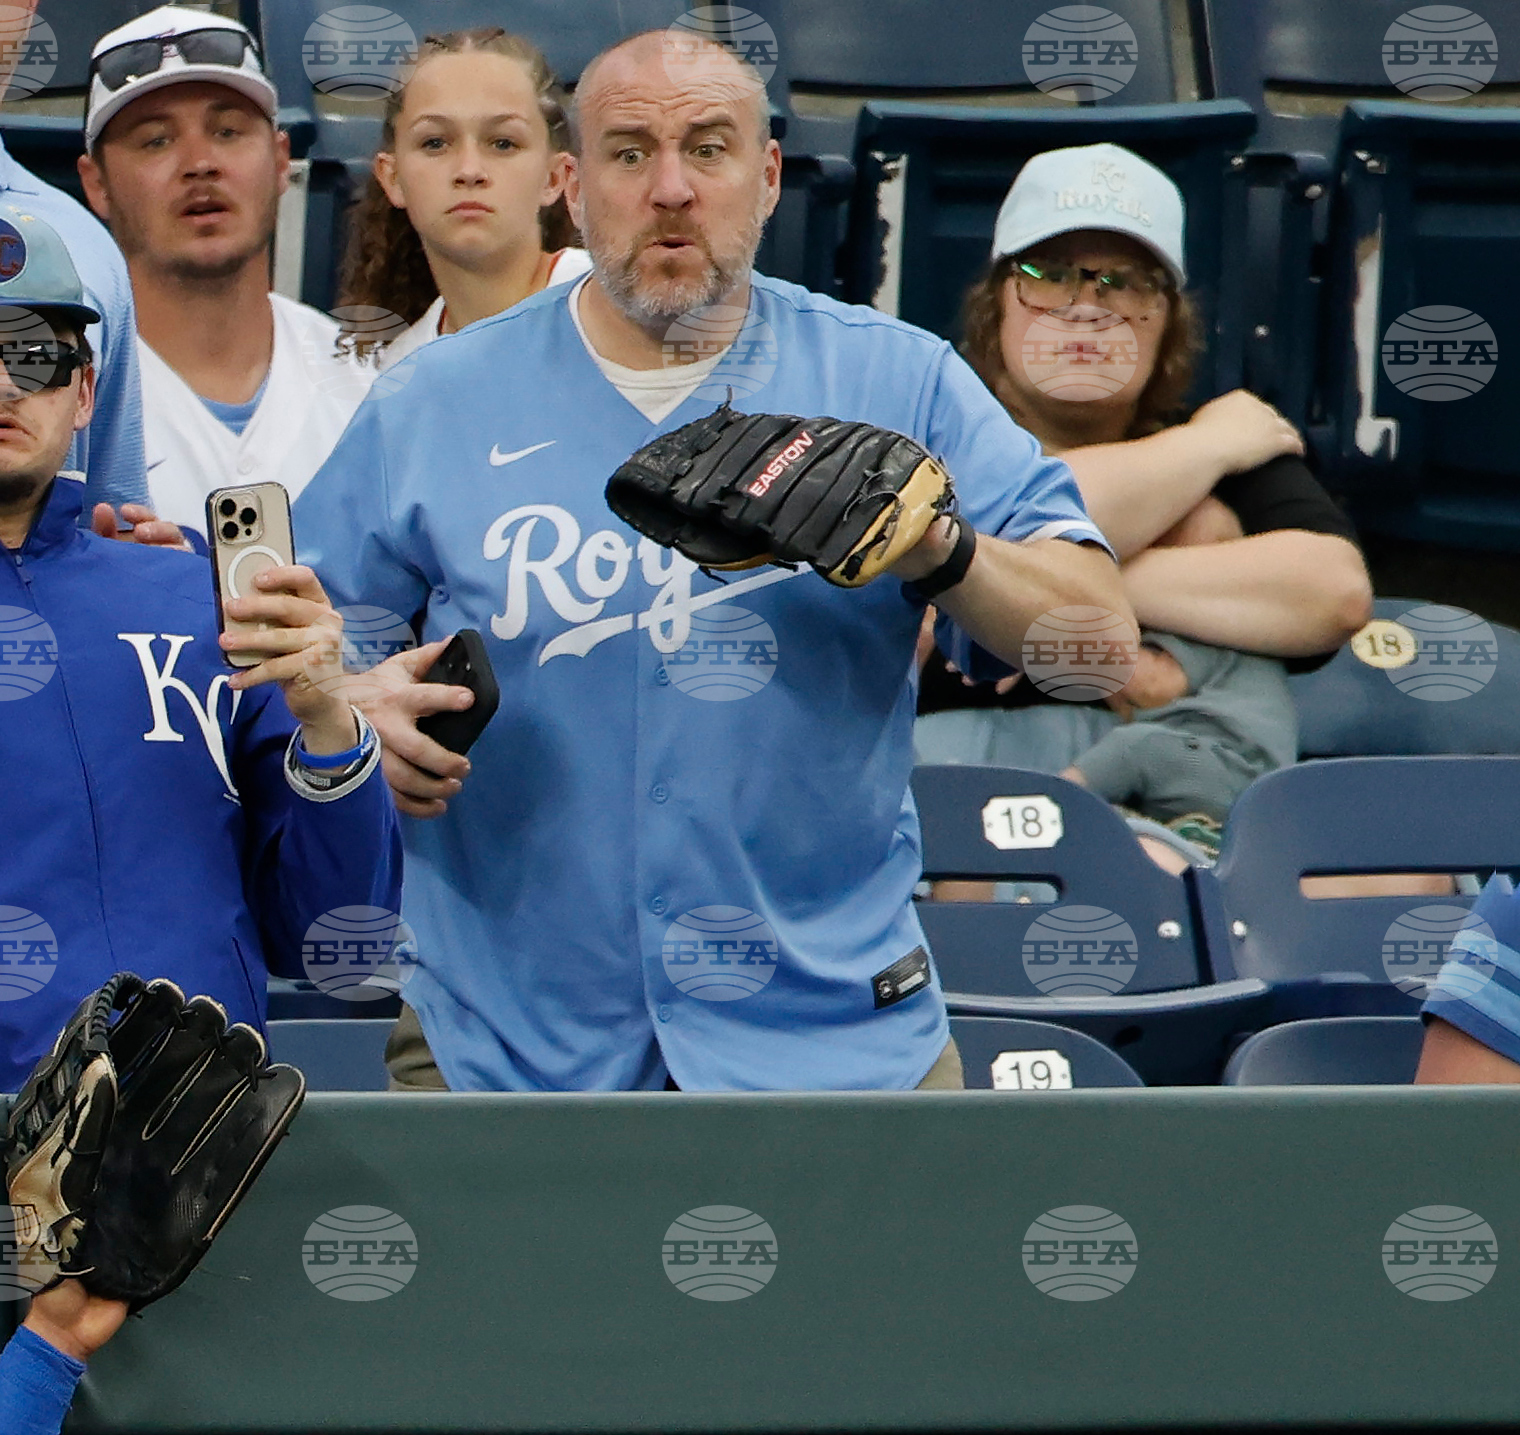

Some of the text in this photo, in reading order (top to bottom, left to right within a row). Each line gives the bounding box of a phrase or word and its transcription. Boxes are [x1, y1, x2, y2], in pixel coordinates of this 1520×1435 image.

[747, 429, 816, 498] EASTON
[483, 503, 700, 655] Roy
[1364, 632, 1403, 657] 18
[1000, 805, 1043, 839] 18
[1008, 1060, 1053, 1091] 19
